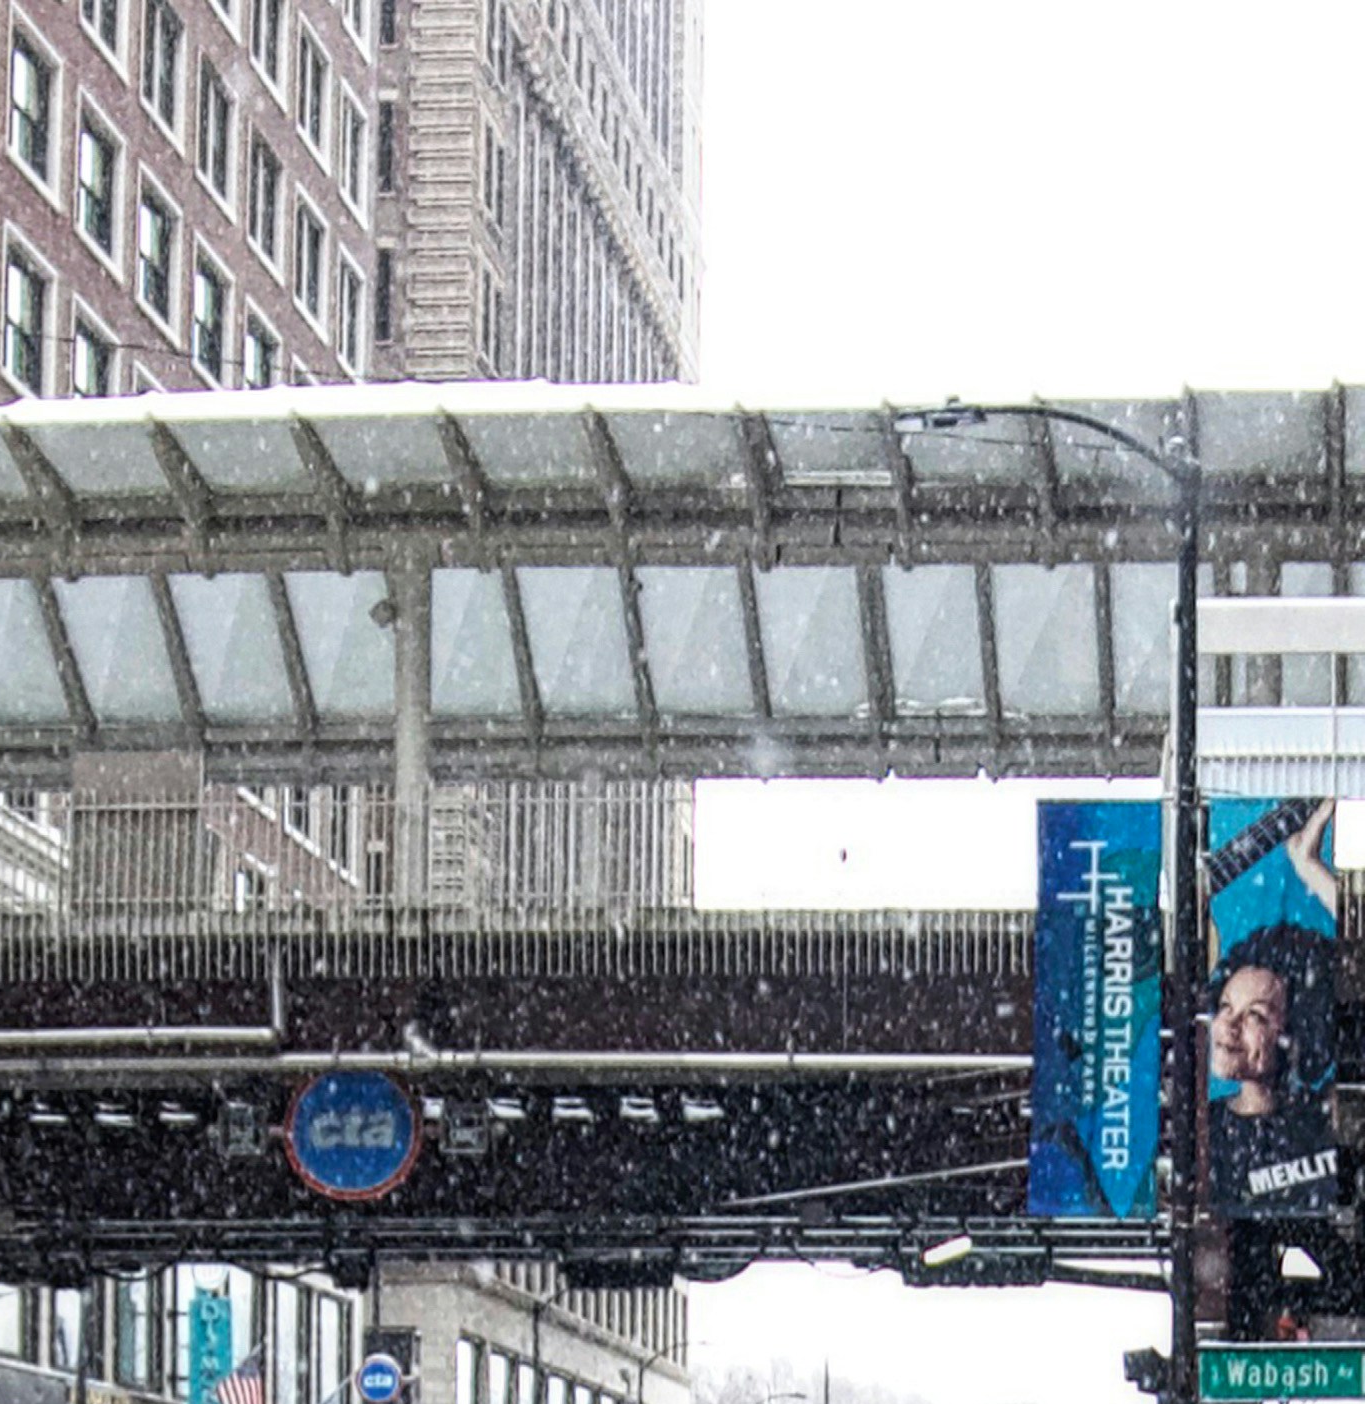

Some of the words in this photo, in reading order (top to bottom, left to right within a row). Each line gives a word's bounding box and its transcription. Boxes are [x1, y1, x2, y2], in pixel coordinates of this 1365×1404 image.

[1103, 885, 1133, 1019] HARRIS
[1101, 1022, 1132, 1171] THEATER
[312, 1104, 394, 1148] cta
[1248, 1149, 1337, 1195] MEKLIT
[363, 1372, 394, 1388] cta
[1227, 1359, 1329, 1388] Wabash
